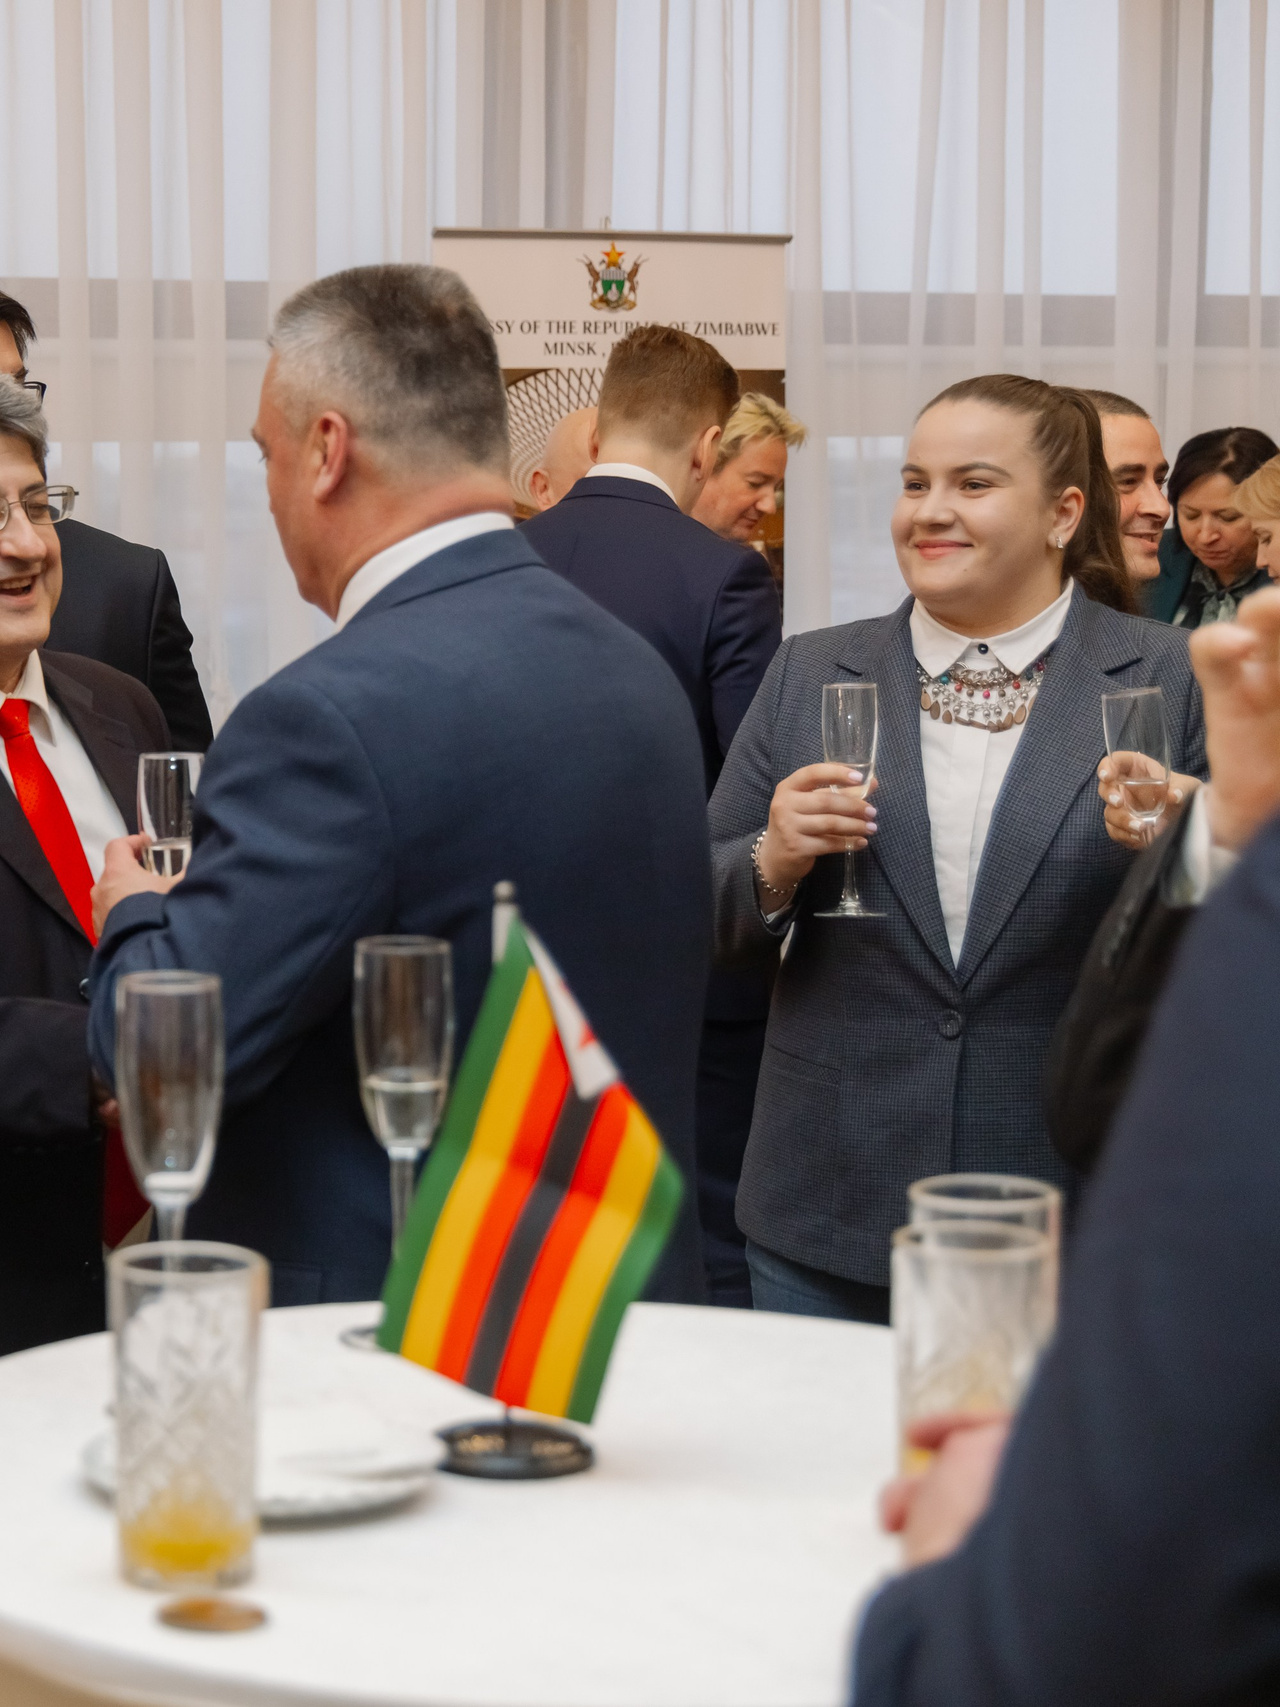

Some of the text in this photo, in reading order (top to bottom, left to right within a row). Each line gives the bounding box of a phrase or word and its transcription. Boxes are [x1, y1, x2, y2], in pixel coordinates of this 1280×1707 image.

[520, 320, 540, 335] OF
[545, 320, 578, 335] THE
[582, 320, 659, 336] REPUB
[694, 321, 781, 336] ZIMBABWE
